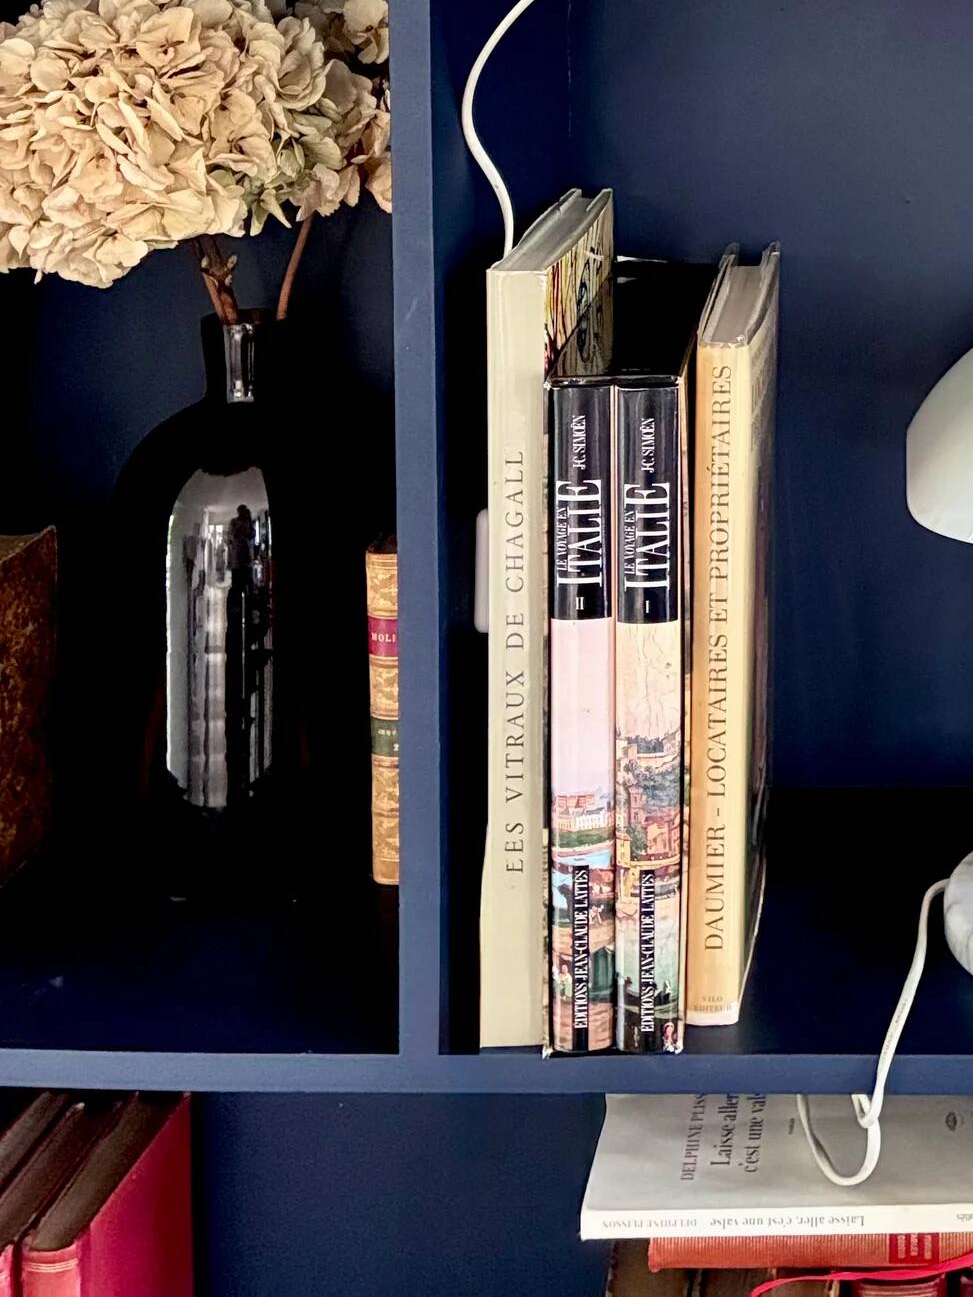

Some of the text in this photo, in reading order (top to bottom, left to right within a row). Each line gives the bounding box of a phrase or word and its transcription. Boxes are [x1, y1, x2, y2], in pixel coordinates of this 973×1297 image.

[556, 478, 603, 588] ITALIE
[556, 506, 568, 572] LE VOYAGE EN
[624, 482, 670, 592] ITALIE
[624, 510, 637, 576] LE VOYAGE EN
[504, 450, 525, 803] VITRAUX DE CHAGALL
[575, 596, 585, 611] II
[645, 599, 650, 614] I
[704, 364, 732, 951] DAUMIER LOCATAIRES ET PROPRIÉTAIRES
[640, 873, 655, 909] LATTÈS
[574, 906, 589, 981] JEAN-CLAUDE
[640, 909, 655, 985] JEAN-CLAUDE
[680, 1122, 705, 1182] DELPHINE
[710, 1124, 736, 1167] Laisse
[738, 1116, 765, 1174] c'est une
[602, 1218, 698, 1229] DELPHINE PLISSON
[709, 1216, 740, 1229] valse
[742, 1216, 764, 1227] une
[766, 1215, 794, 1228] c'est
[828, 1214, 865, 1228] Laisse
